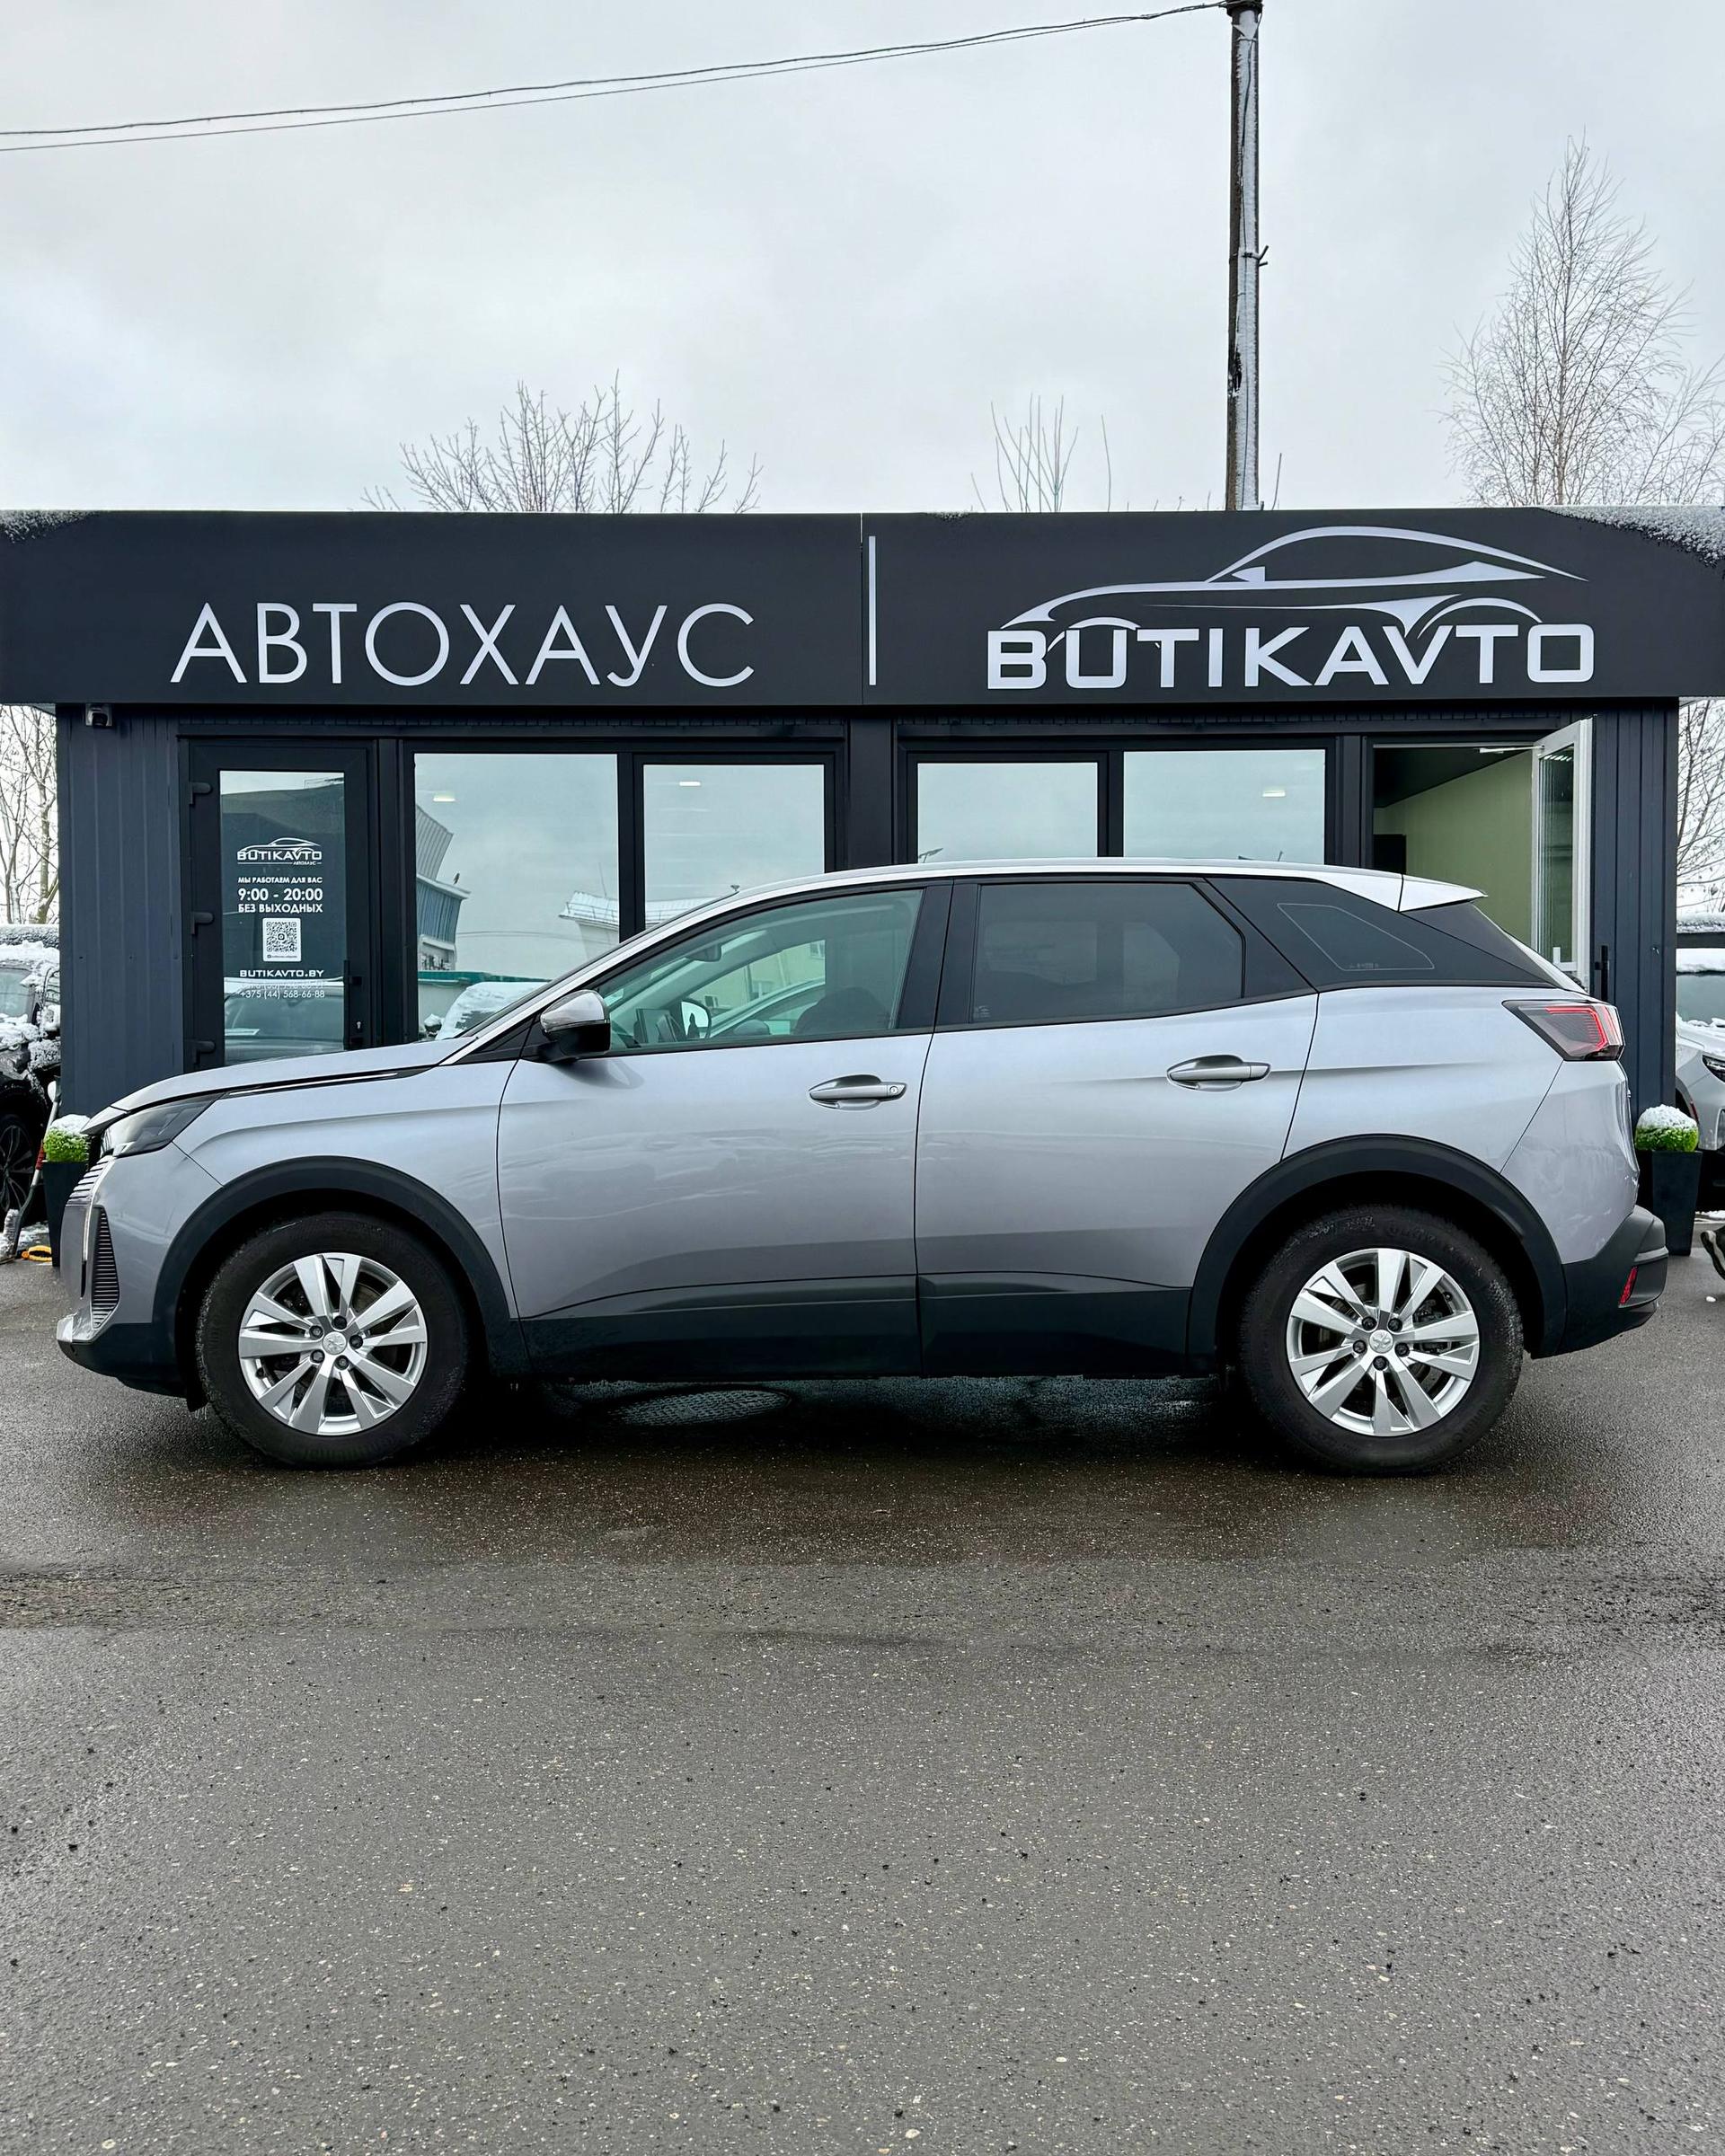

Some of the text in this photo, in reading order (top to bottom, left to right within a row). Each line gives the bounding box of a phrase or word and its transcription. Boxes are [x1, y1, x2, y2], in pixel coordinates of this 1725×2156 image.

[170, 602, 755, 687] АВТОХАУС
[987, 623, 1595, 690] BUTIKAVTO
[236, 851, 322, 861] BUTIKAVTO
[238, 888, 269, 901] 9:00
[283, 888, 323, 901] 20:00
[238, 904, 323, 914] БЕЗ ВЫХОДНЫХ
[240, 990, 261, 998] +375
[264, 990, 280, 999] (44)
